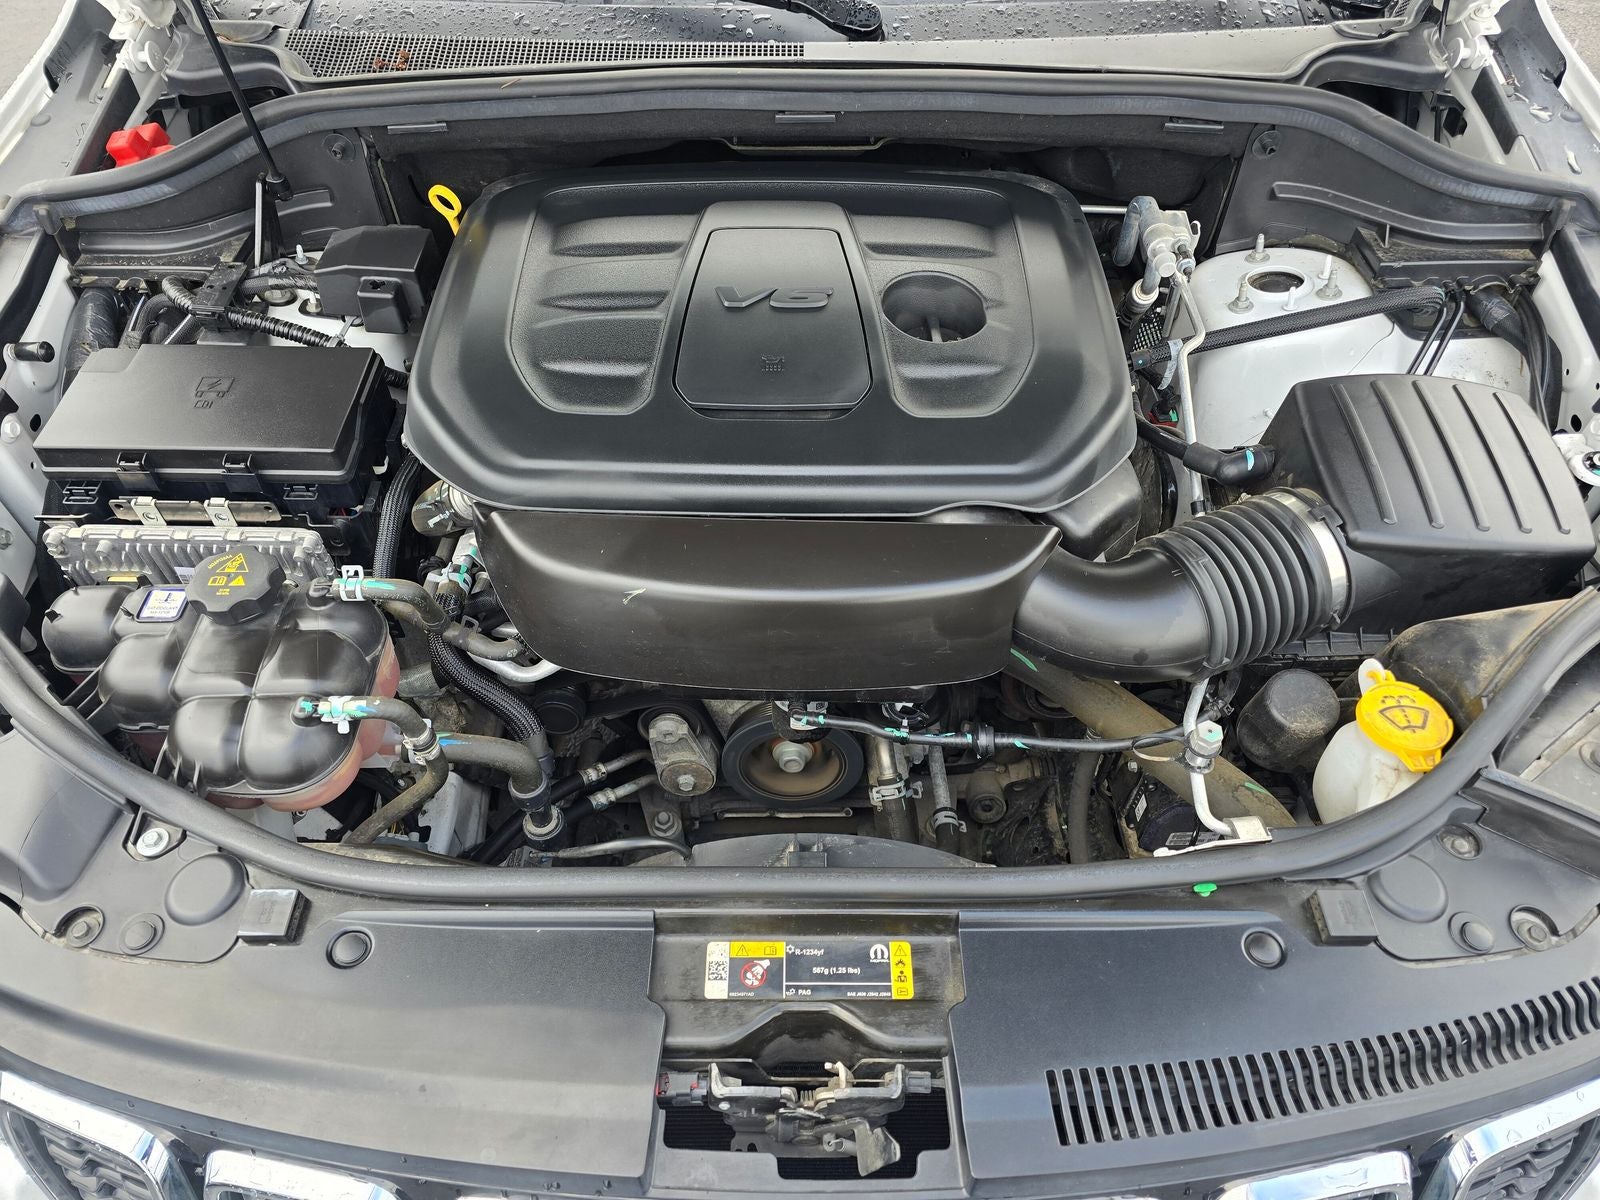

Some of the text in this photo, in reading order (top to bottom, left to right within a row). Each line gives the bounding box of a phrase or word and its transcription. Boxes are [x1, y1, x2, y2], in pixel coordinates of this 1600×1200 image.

[714, 286, 834, 309] V6
[795, 948, 824, 957] R-1234yf
[812, 967, 861, 976] 567g (1.25 lbs)
